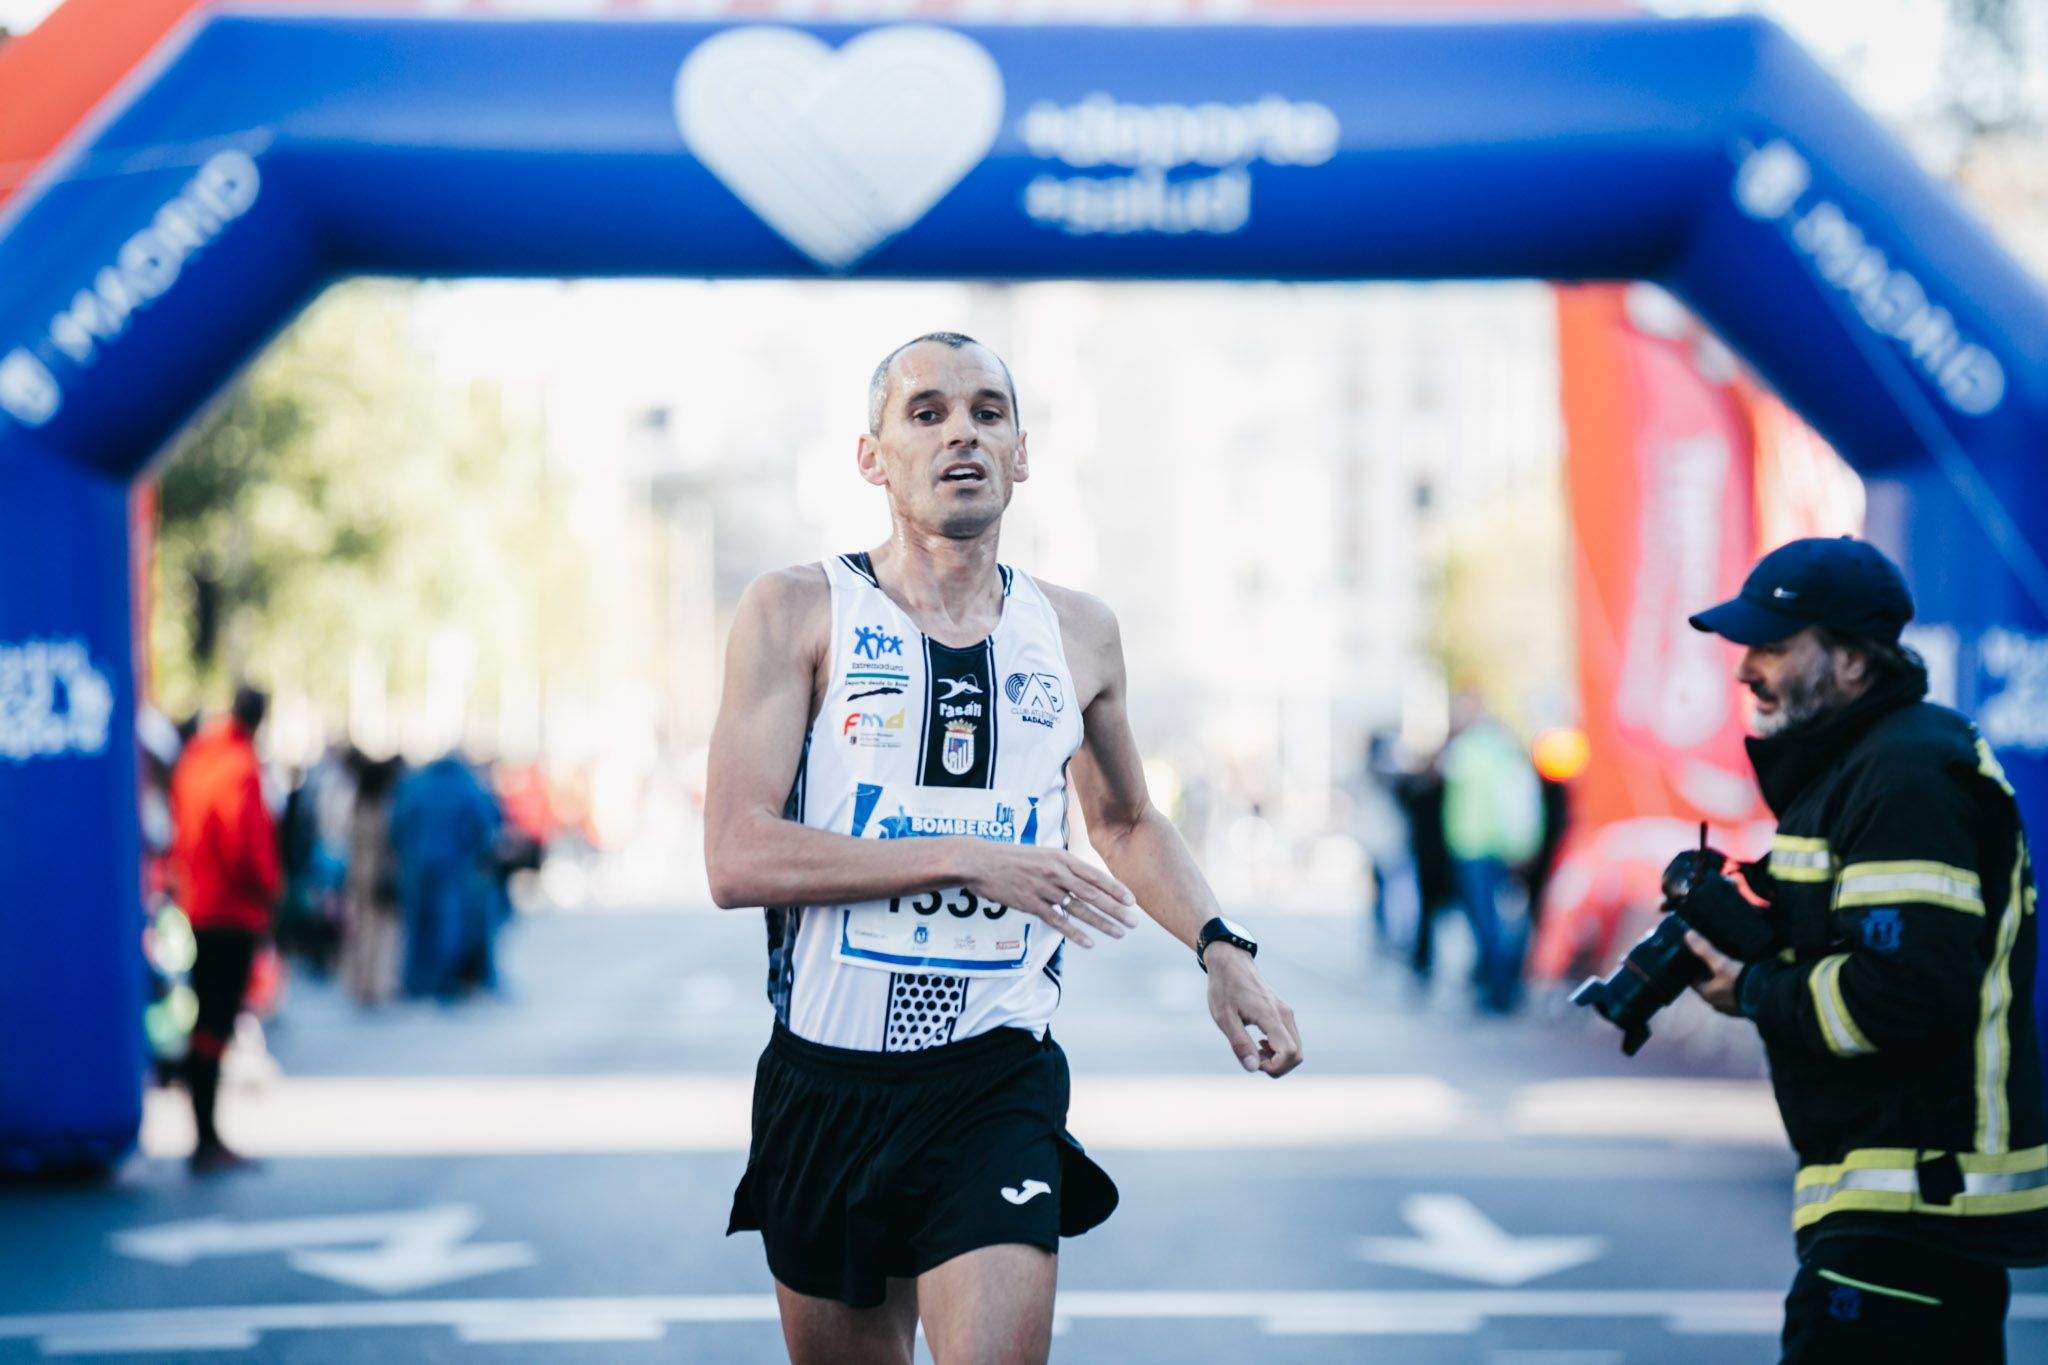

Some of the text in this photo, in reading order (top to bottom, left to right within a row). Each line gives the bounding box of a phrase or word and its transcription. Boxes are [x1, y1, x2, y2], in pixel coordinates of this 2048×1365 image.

[50, 148, 261, 364] MADRID
[1793, 201, 2005, 416] MADRID
[1022, 715, 1053, 728] BADAJOZ
[911, 816, 1013, 837] BOMBEROS
